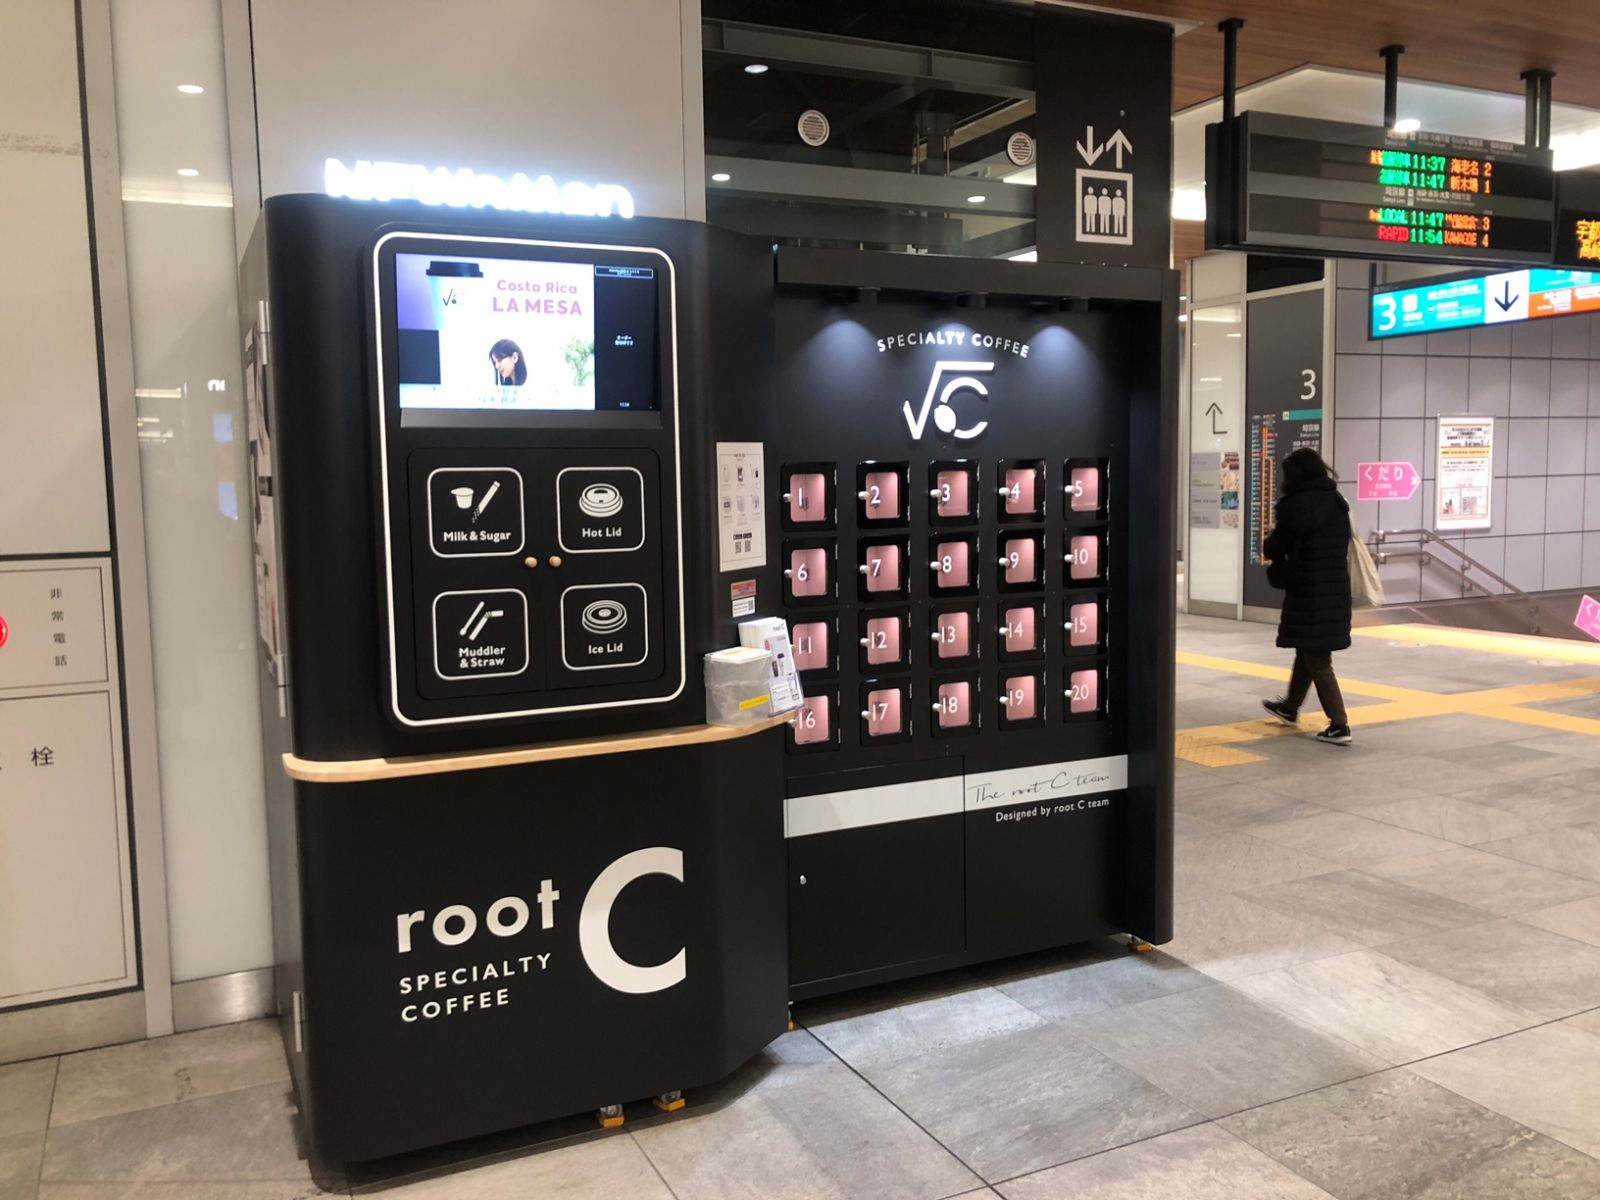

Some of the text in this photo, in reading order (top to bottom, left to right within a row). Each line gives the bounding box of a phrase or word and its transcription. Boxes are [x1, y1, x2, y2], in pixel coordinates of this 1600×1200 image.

[1412, 154, 1446, 172] 11:37
[1451, 158, 1479, 176] 海老名
[1484, 162, 1492, 177] 2
[1412, 172, 1445, 189] 11:47
[1485, 180, 1491, 194] 1
[1378, 208, 1408, 225] LOCAL
[1410, 210, 1443, 227] 11:47
[1482, 217, 1490, 231] 3
[1378, 226, 1409, 243] RAPID
[1410, 229, 1443, 245] 11:54
[1481, 234, 1489, 248] 4
[497, 280, 577, 294] Costa Rica
[493, 297, 582, 316] LA MESA
[1378, 298, 1396, 331] 3
[877, 331, 1030, 358] SPECIALTY COFFEE
[1300, 369, 1316, 400] 3
[1364, 466, 1403, 480] くだり
[798, 487, 802, 507] 1
[870, 486, 880, 504] 2
[942, 484, 950, 502] 3
[1010, 482, 1020, 500] 4
[1074, 480, 1083, 497] 5
[443, 530, 511, 543] Milk & Sugar
[582, 528, 622, 538] Hot Lid
[942, 556, 952, 573] 8
[1010, 552, 1019, 568] 9
[1074, 548, 1088, 565] 10
[798, 564, 807, 581] 6
[872, 559, 882, 577] 7
[51, 588, 67, 667] 非常電話
[1008, 621, 1023, 638] 14
[1074, 617, 1087, 633] 15
[871, 631, 887, 649] 12
[941, 626, 956, 643] 13
[459, 646, 506, 658] Muddler
[588, 643, 623, 654] Ice Lid
[798, 636, 811, 655] 11
[460, 657, 505, 668] & Straw
[1010, 689, 1024, 707] 19
[1073, 684, 1089, 701] 20
[872, 703, 888, 720] 17
[942, 697, 958, 714] 18
[800, 711, 816, 730] 16
[968, 771, 1110, 803] The root C team
[996, 798, 1109, 822] Designed by root C team
[397, 847, 686, 994] root C
[400, 952, 551, 994] SPECIALTY
[401, 988, 510, 1023] COFFEE
